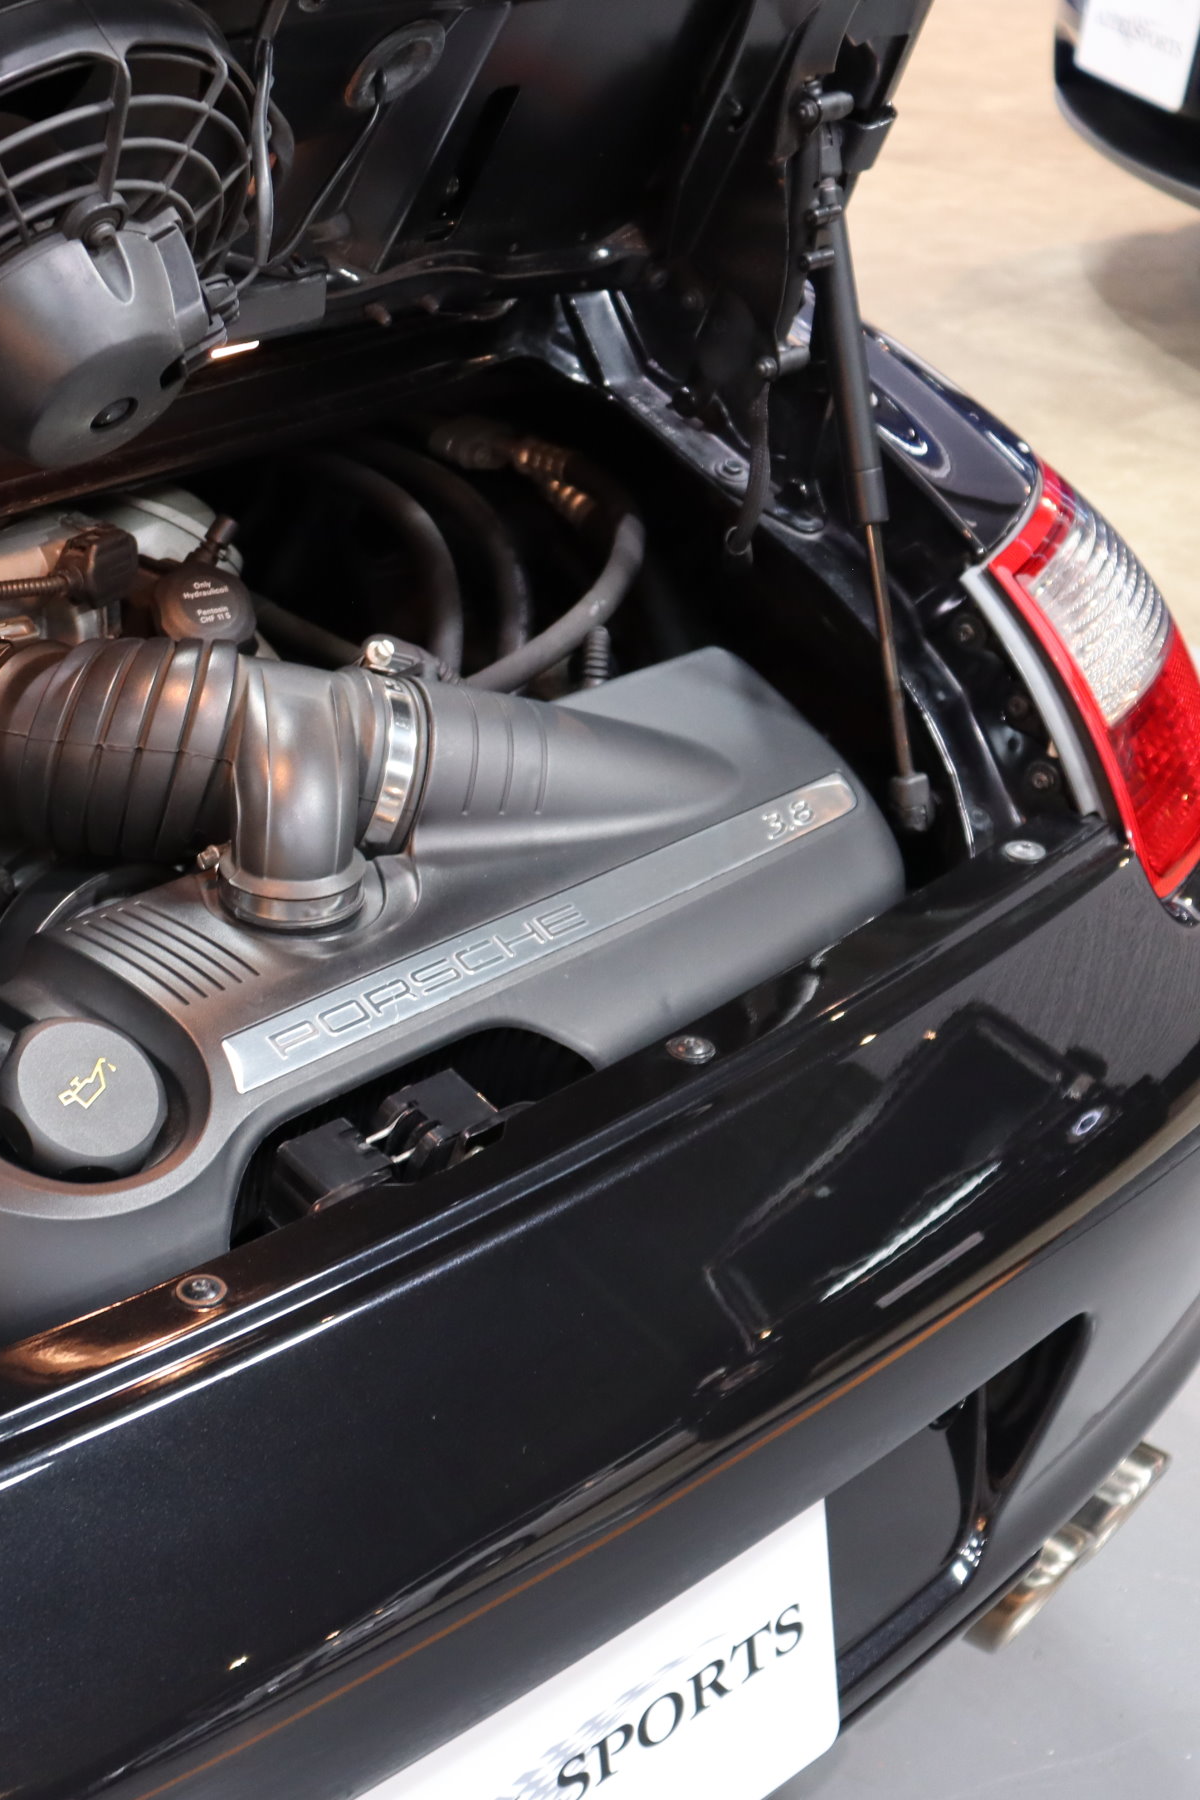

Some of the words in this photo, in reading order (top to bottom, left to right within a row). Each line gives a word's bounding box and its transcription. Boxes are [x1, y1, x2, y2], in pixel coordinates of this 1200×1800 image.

[183, 585, 229, 600] Hydraulicoil
[193, 581, 211, 590] Only
[197, 606, 228, 617] Pentosin
[200, 615, 215, 624] CHF
[762, 800, 815, 841] 3.8
[268, 904, 588, 1059] PORSCHE
[556, 1603, 805, 1800] SPORTS
